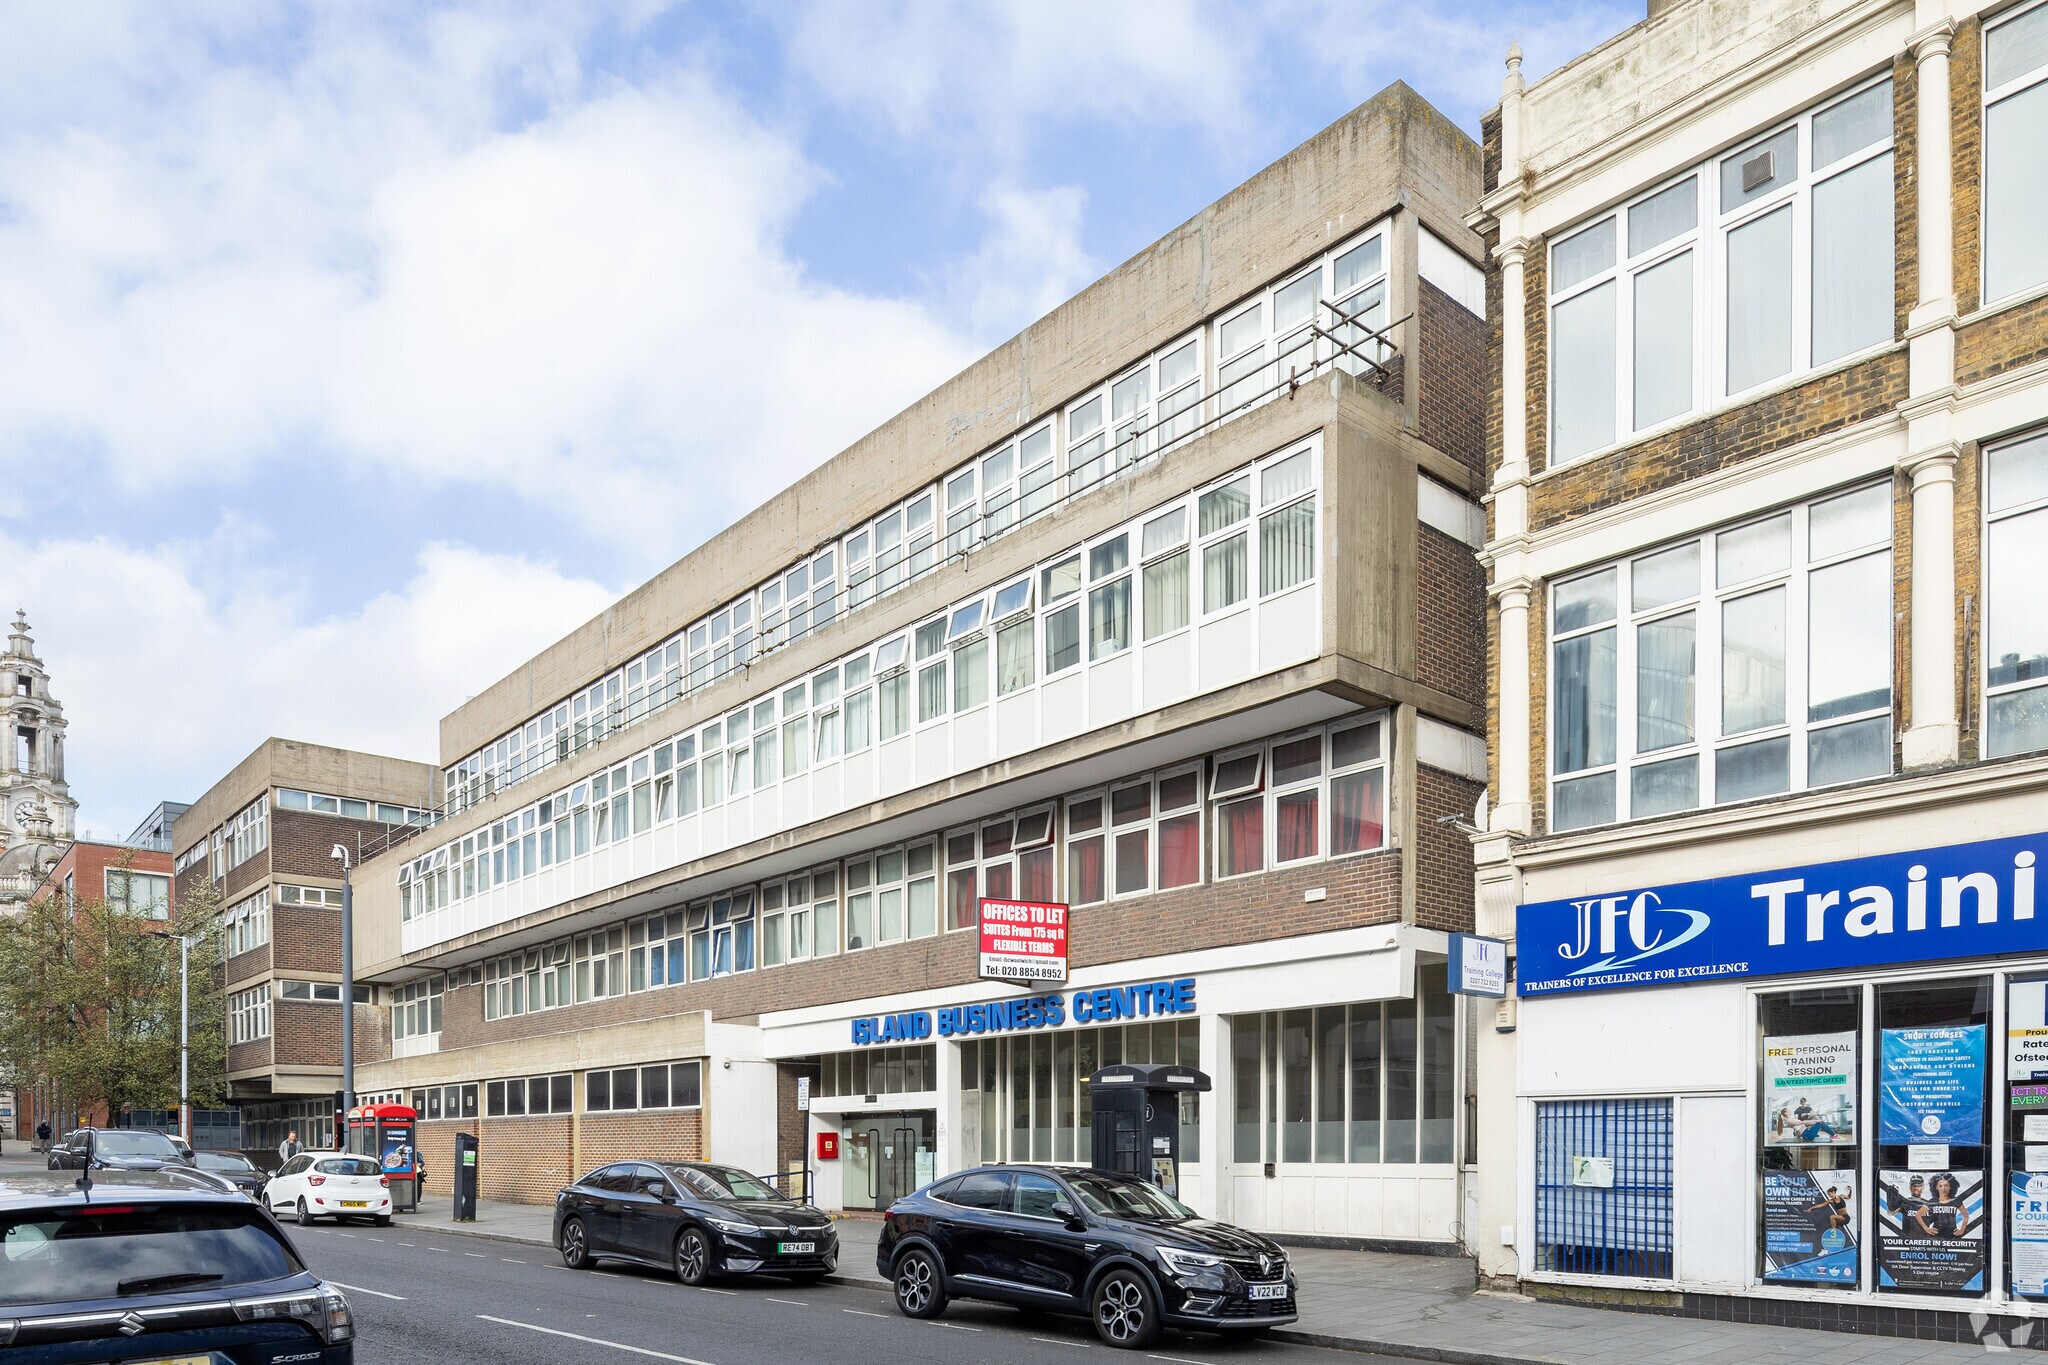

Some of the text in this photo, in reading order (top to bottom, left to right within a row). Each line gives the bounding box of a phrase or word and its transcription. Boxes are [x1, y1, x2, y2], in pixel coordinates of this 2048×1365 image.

[1751, 850, 2036, 946] Traini
[983, 903, 1065, 924] OFFICES TO LET
[1557, 891, 1662, 960] JFC
[983, 923, 1064, 940] SUITES From 175 sq ft
[993, 939, 1055, 954] FLEXIBLE TERMS
[1473, 942, 1490, 963] JFC
[986, 965, 1062, 979] Tel: 020 8854 8952
[1464, 966, 1503, 980] Training College
[1525, 962, 1749, 992] TRAINERS OF EXCELLENCE FOR EXCELLENCE
[851, 978, 1197, 1045] ISLAND BUSINESS CENTRE
[1903, 1031, 1963, 1040] SHORT COURSES
[1768, 1044, 1852, 1057] FREE PERSONAL
[1784, 1056, 1835, 1065] TRAINING
[1787, 1066, 1832, 1076] SESSION
[2011, 1087, 2031, 1096] ICT
[2011, 1095, 2047, 1105] EVERY
[1765, 1176, 1807, 1187] BE YOUR
[1765, 1187, 1819, 1197] OWN BOSS
[1932, 1205, 1957, 1214] SECURITY
[2016, 1200, 2048, 1212] FR
[2015, 1213, 2048, 1221] COUR
[1830, 1229, 1837, 1239] 3
[783, 1243, 800, 1252] RE74
[1900, 1252, 1957, 1261] ENROL NOW!
[1252, 1286, 1270, 1297] LV22
[271, 1351, 322, 1365] S-CROSS
